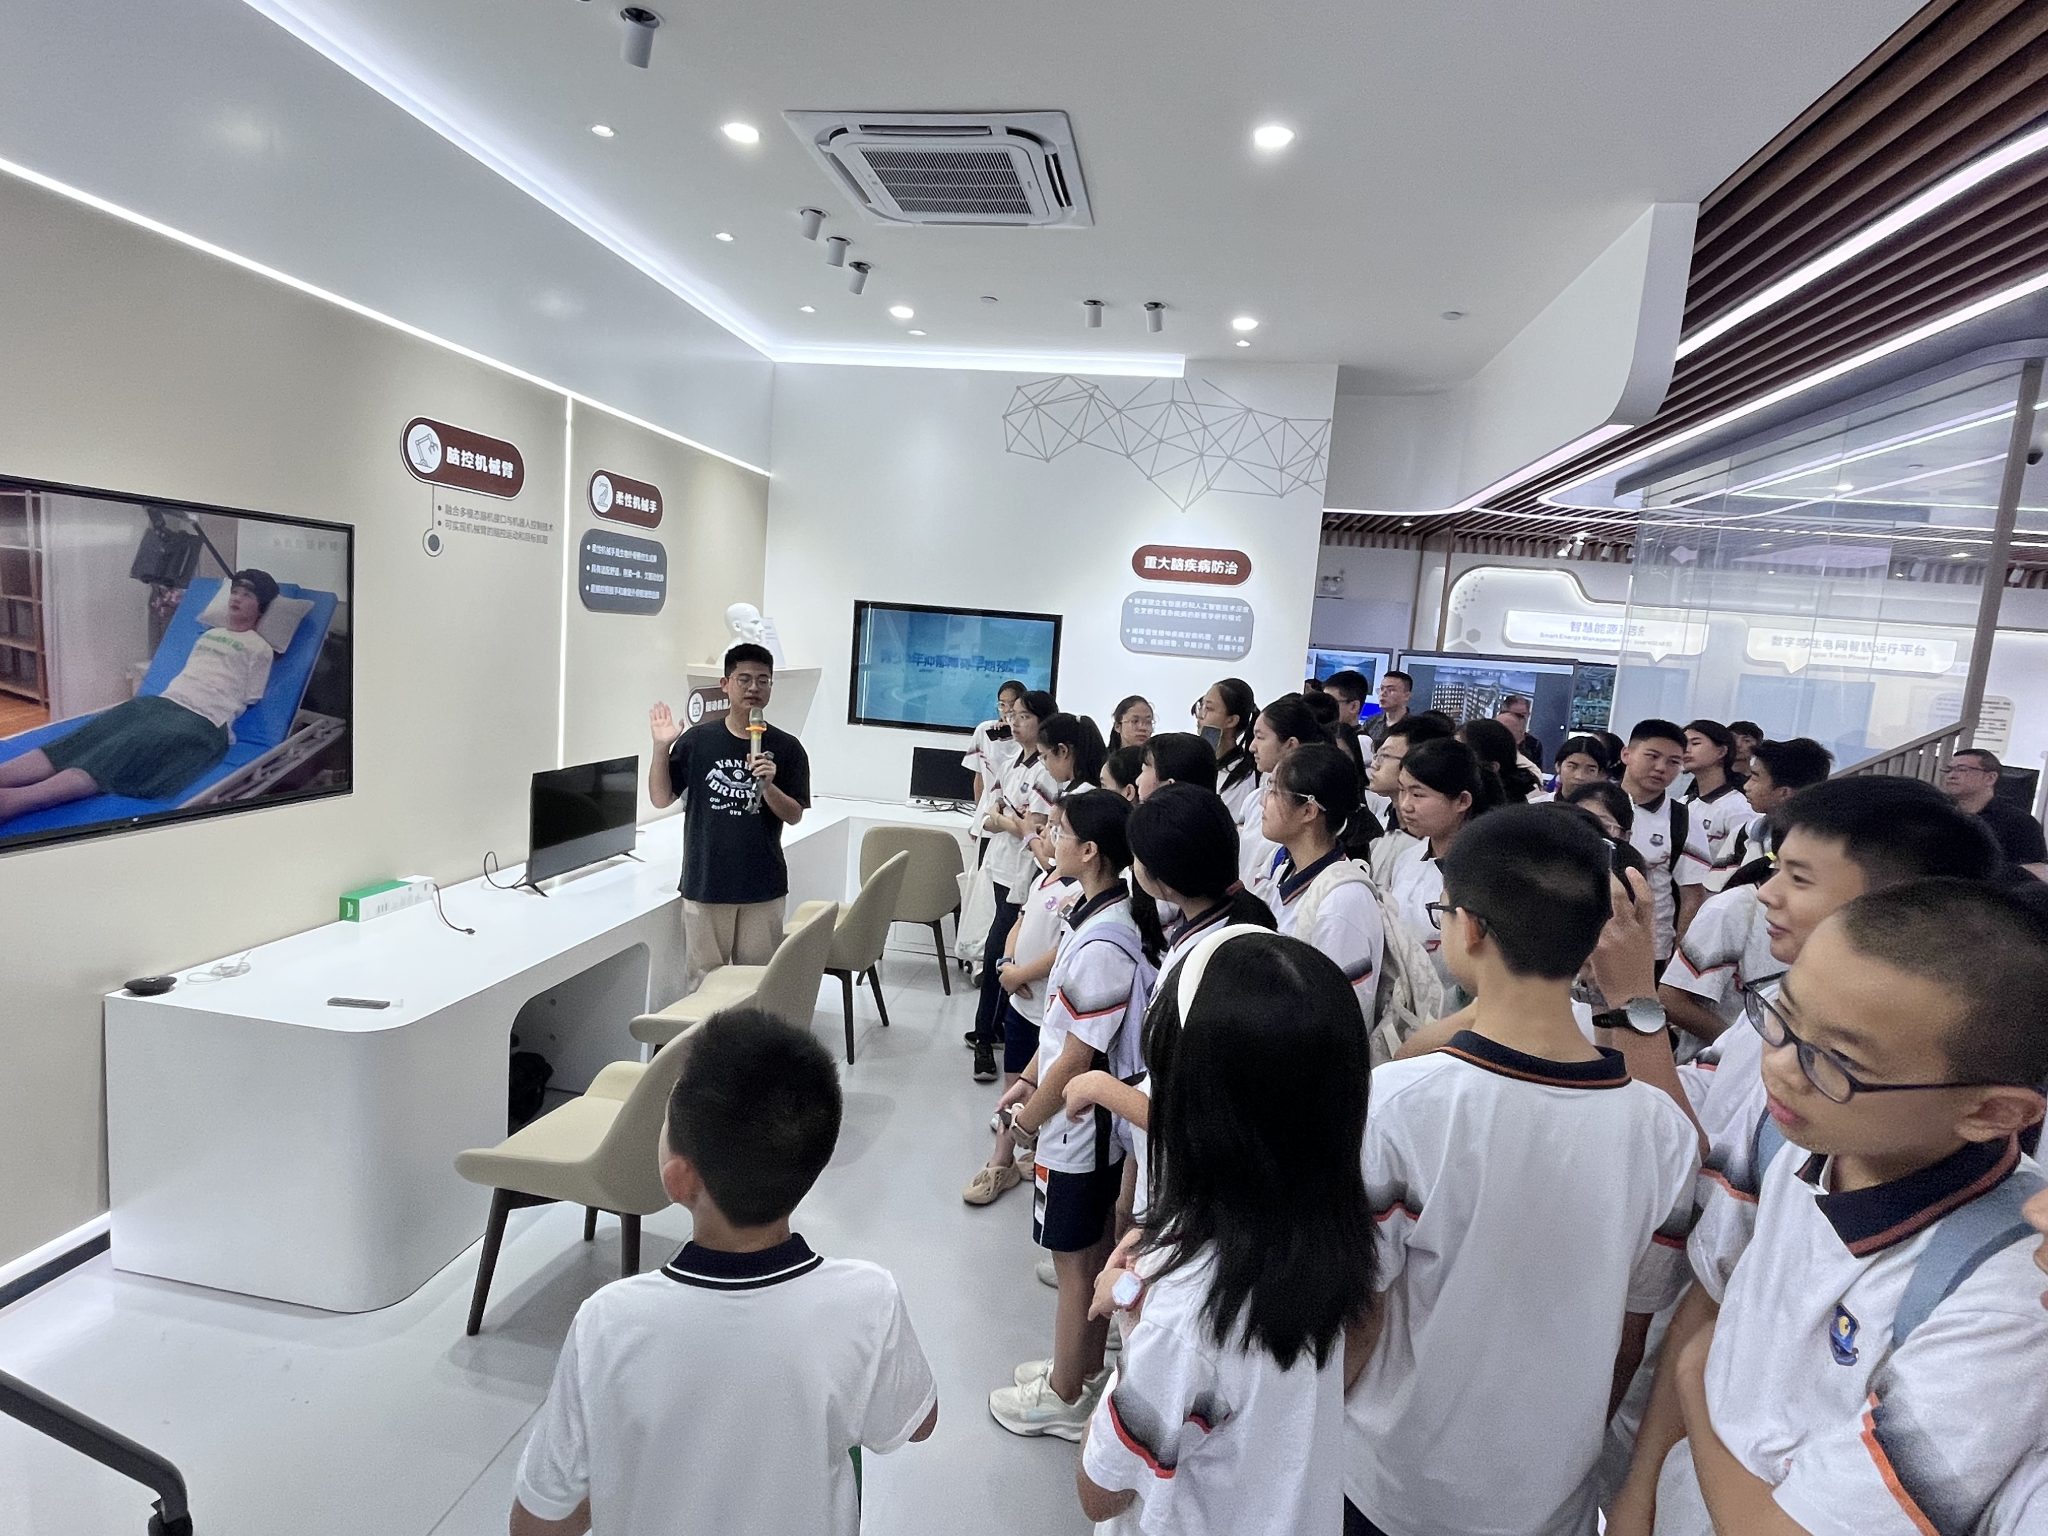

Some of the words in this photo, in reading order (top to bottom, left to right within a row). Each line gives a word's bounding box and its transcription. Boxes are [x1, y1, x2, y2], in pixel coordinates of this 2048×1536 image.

[446, 446, 514, 479] 脑控机械臂
[615, 490, 658, 514] 柔性机械手
[1143, 555, 1239, 575] 重大脑疾病防治
